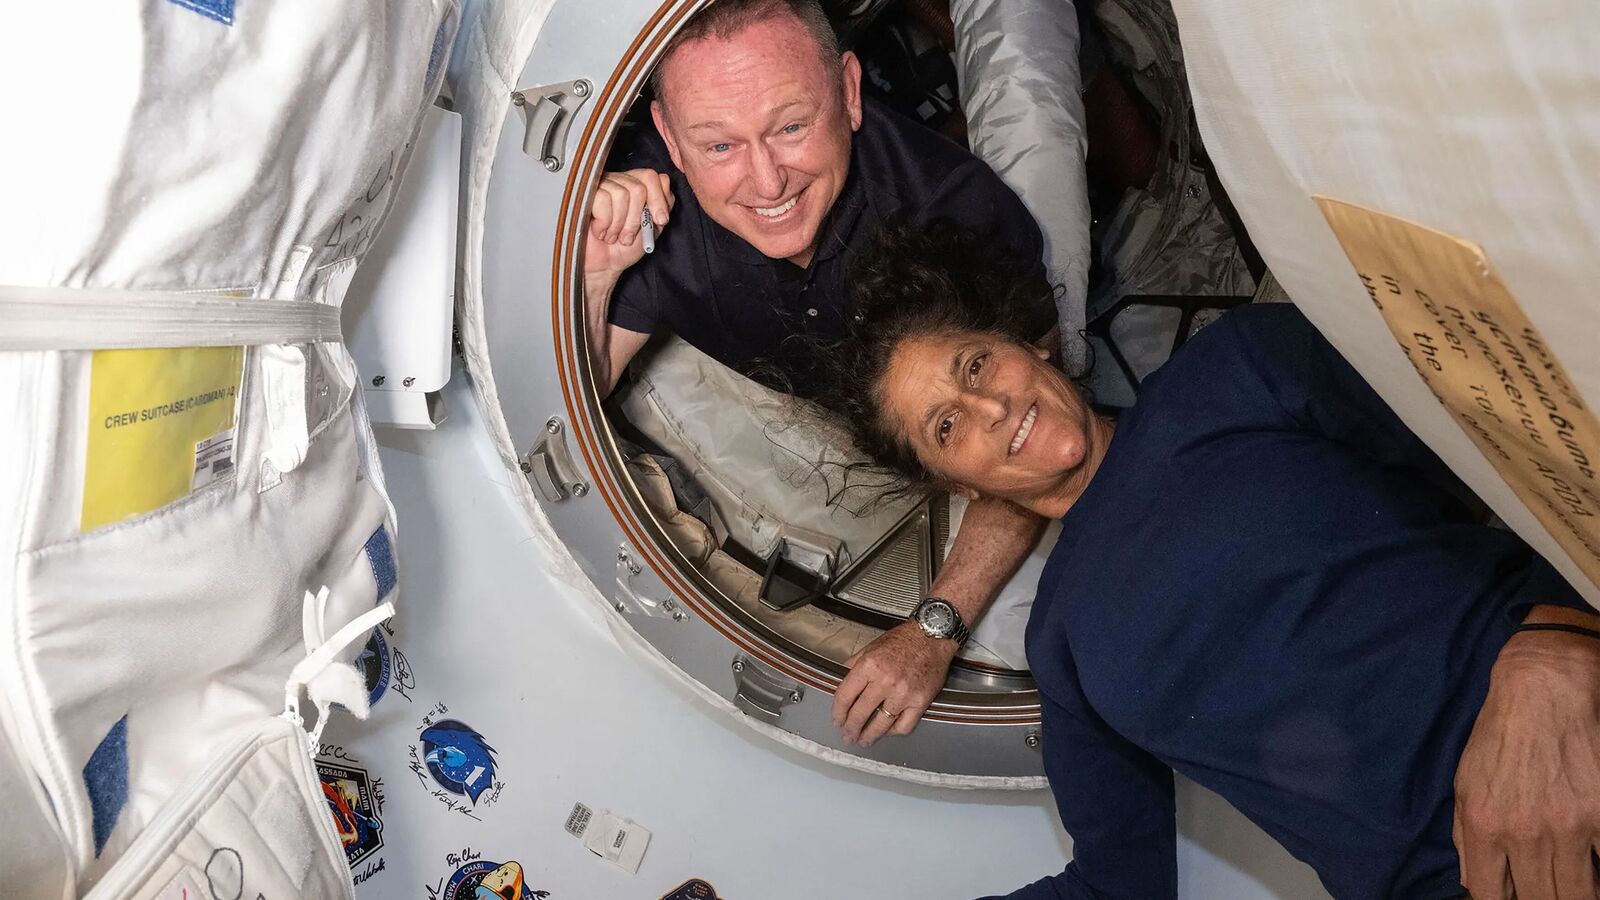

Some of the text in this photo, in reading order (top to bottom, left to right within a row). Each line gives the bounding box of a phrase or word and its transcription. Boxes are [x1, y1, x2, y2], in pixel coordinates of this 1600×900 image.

[1380, 274, 1401, 295] in
[1413, 331, 1443, 372] the
[1414, 288, 1469, 360] cover
[1445, 305, 1548, 449] положении
[1469, 309, 1595, 480] установить
[105, 411, 138, 429] CREW
[141, 400, 185, 422] SUITCASE
[317, 766, 348, 778] ASSADA
[462, 863, 484, 875] CHARI
